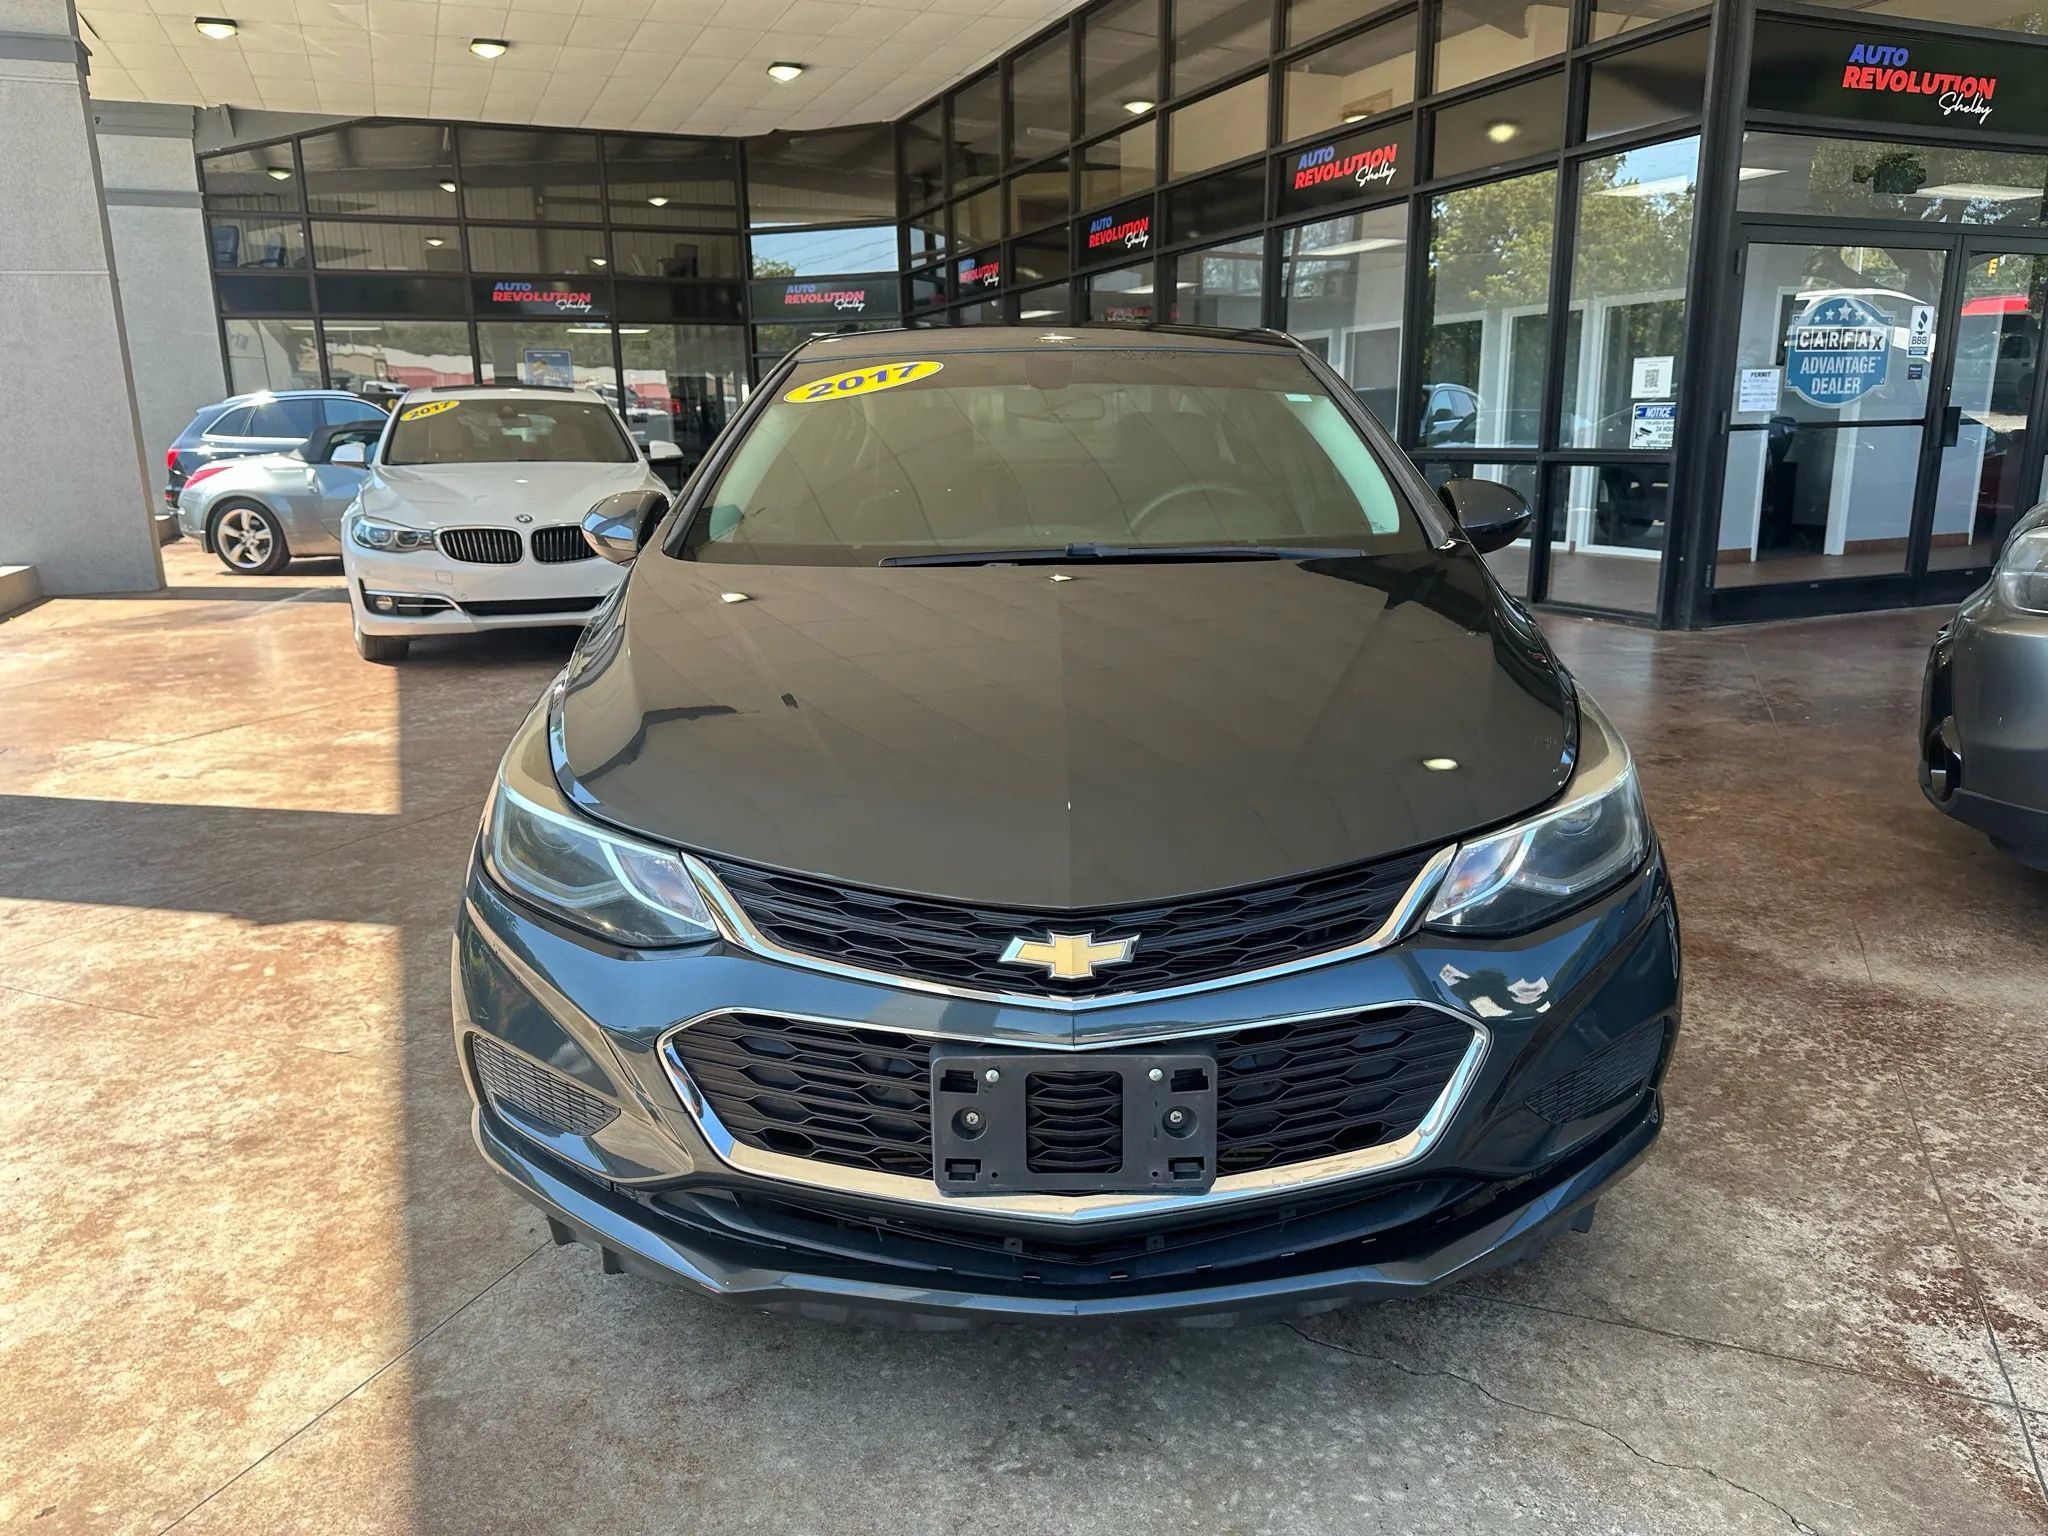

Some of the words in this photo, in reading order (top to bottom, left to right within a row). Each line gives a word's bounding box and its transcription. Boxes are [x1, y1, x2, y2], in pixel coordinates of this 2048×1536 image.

[1848, 44, 1909, 66] AUTO
[1842, 65, 1997, 100] REVOLUTION
[1938, 91, 1993, 125] Shelby
[1294, 143, 1398, 189] REVOLUTION
[1297, 145, 1335, 170] AUTO
[1355, 158, 1397, 187] Shelby
[1088, 216, 1149, 248] REVOLUTION
[1090, 216, 1112, 234] AUTO
[493, 282, 532, 291] AUTO
[785, 284, 816, 294] AUTO
[492, 291, 592, 302] REVOLUTION
[784, 290, 865, 304] REVOLUTION
[1799, 331, 1883, 350] CARFAX
[1911, 336, 1927, 345] BBB
[1800, 356, 1877, 374] ADVANTAGE
[805, 363, 920, 400] 2017
[1811, 377, 1861, 395] DEALER
[409, 401, 449, 418] 2017
[1644, 407, 1673, 418] NOTICE
